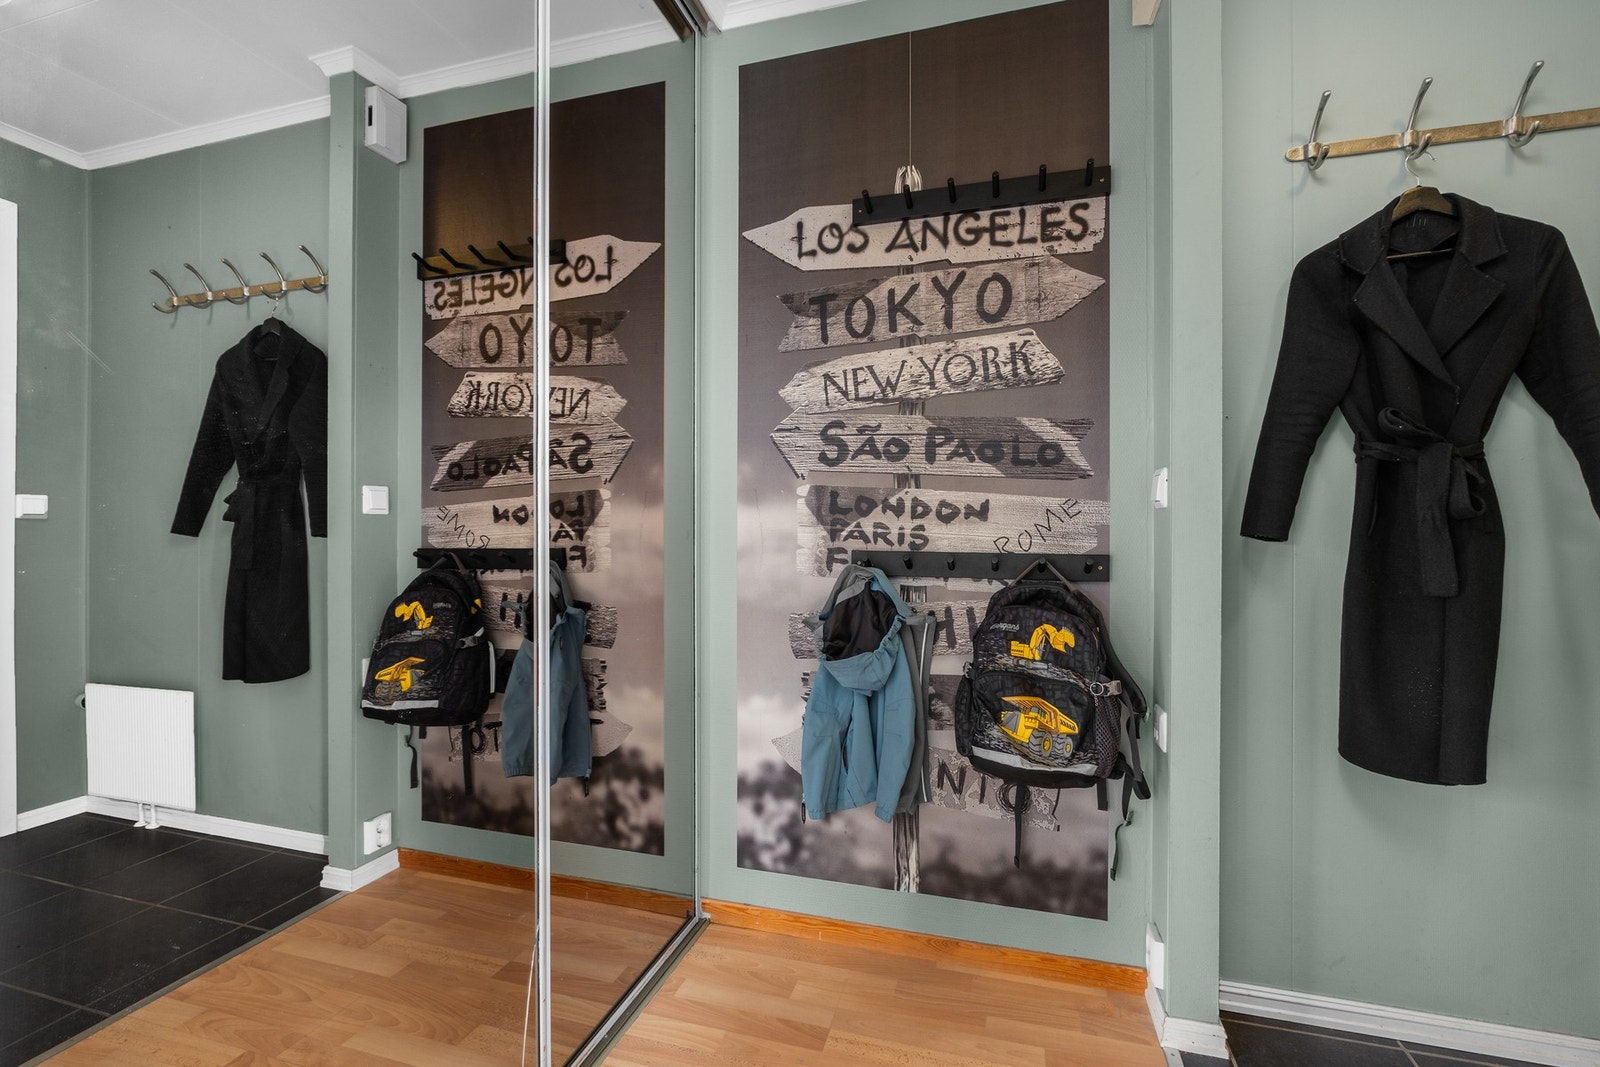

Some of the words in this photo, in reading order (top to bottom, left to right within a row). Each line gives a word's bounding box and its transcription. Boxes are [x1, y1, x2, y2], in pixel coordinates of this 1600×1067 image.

[797, 221, 869, 259] LOS
[885, 202, 1090, 253] ANGELES
[808, 270, 1014, 345] TOKYO
[822, 360, 907, 406] NEW
[917, 340, 1036, 390] YORK
[818, 419, 910, 467] SÃO
[925, 426, 1066, 467] PAOLO
[829, 490, 990, 525] LONDON
[829, 518, 930, 550] PARIS
[993, 498, 1082, 554] ROME
